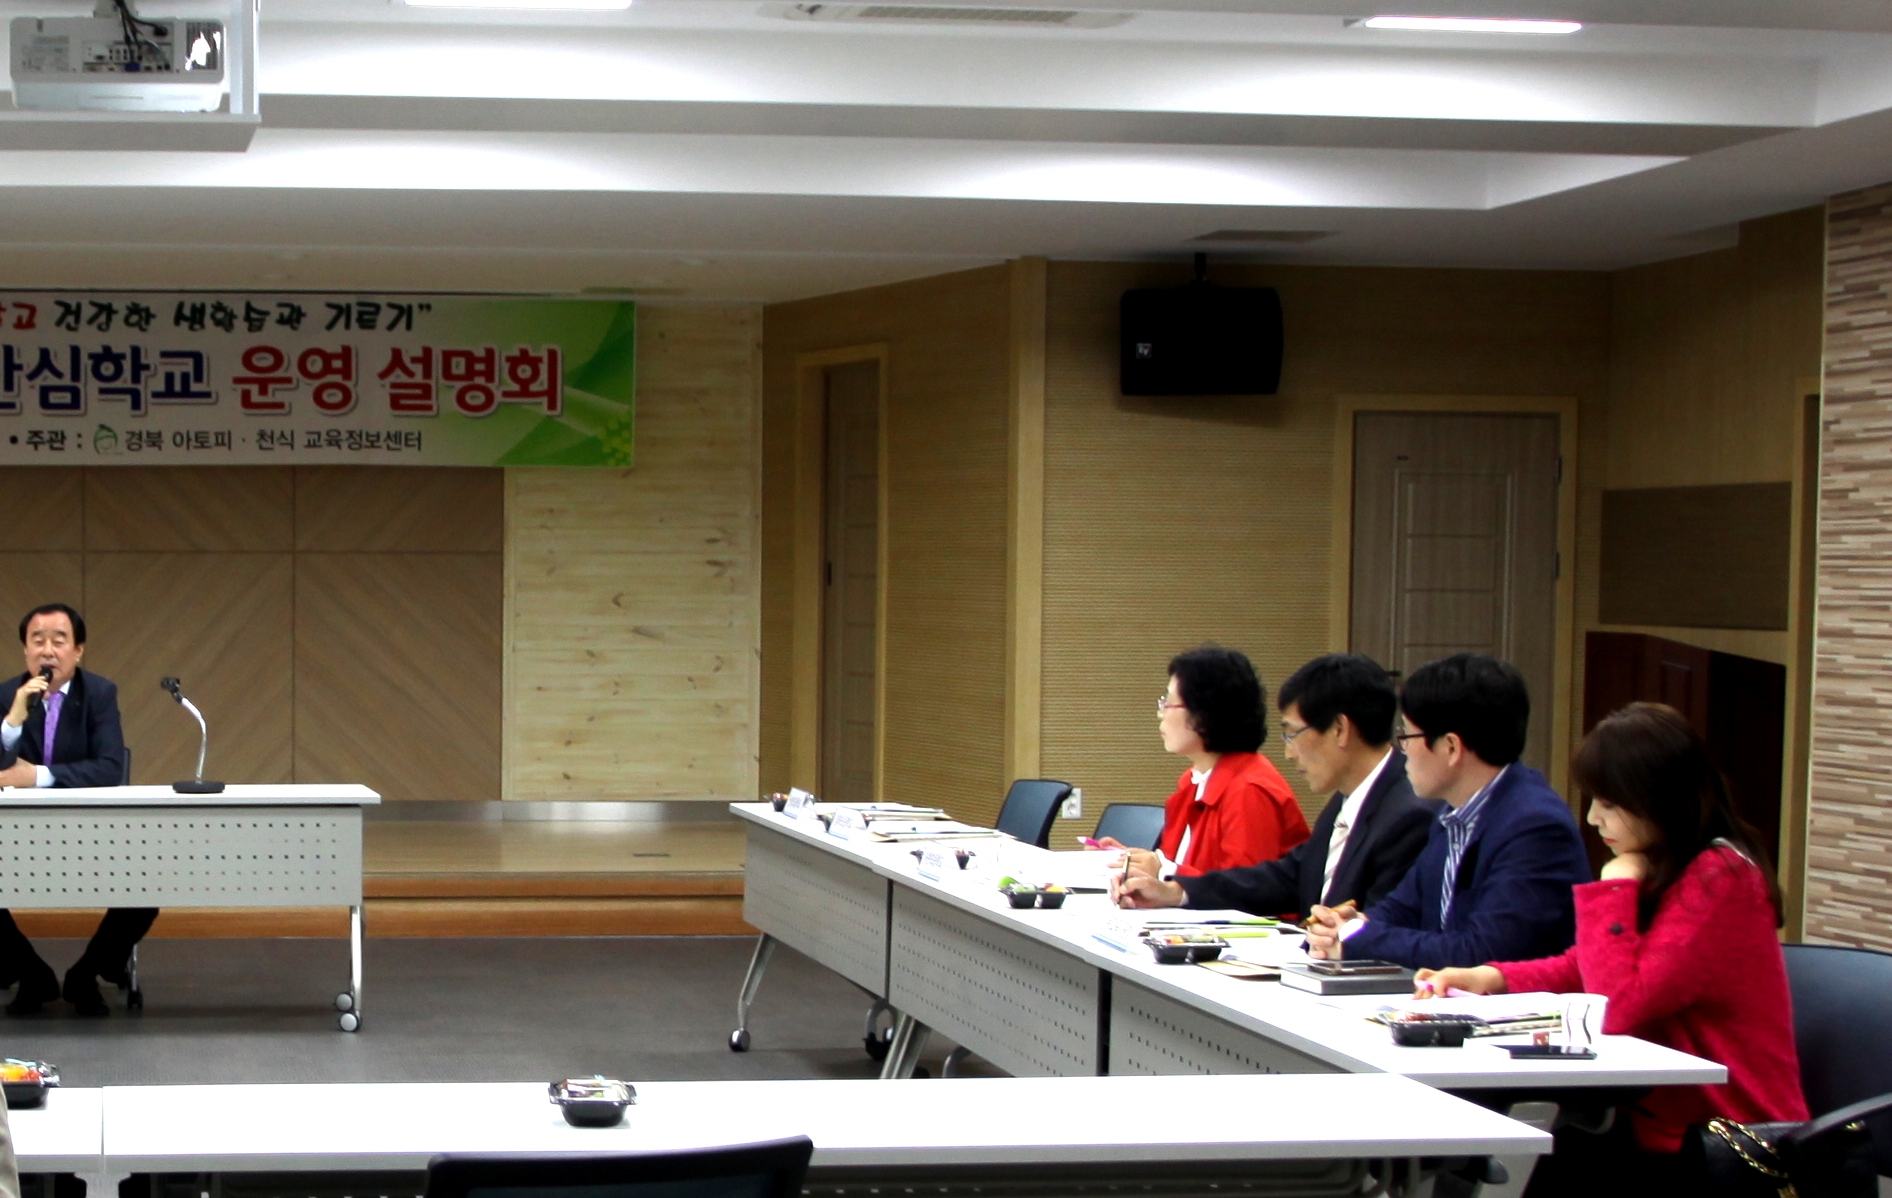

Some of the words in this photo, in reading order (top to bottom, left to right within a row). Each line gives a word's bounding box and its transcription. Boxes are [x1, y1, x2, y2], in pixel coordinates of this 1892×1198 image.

[54, 300, 156, 332] 건강한
[173, 300, 307, 333] 생활습관
[232, 345, 353, 411] 운영
[377, 346, 559, 412] 설명회
[124, 430, 164, 451] 경북
[172, 430, 232, 451] 아토피
[256, 430, 295, 451] 천식
[304, 429, 422, 451] 교육정보센터
